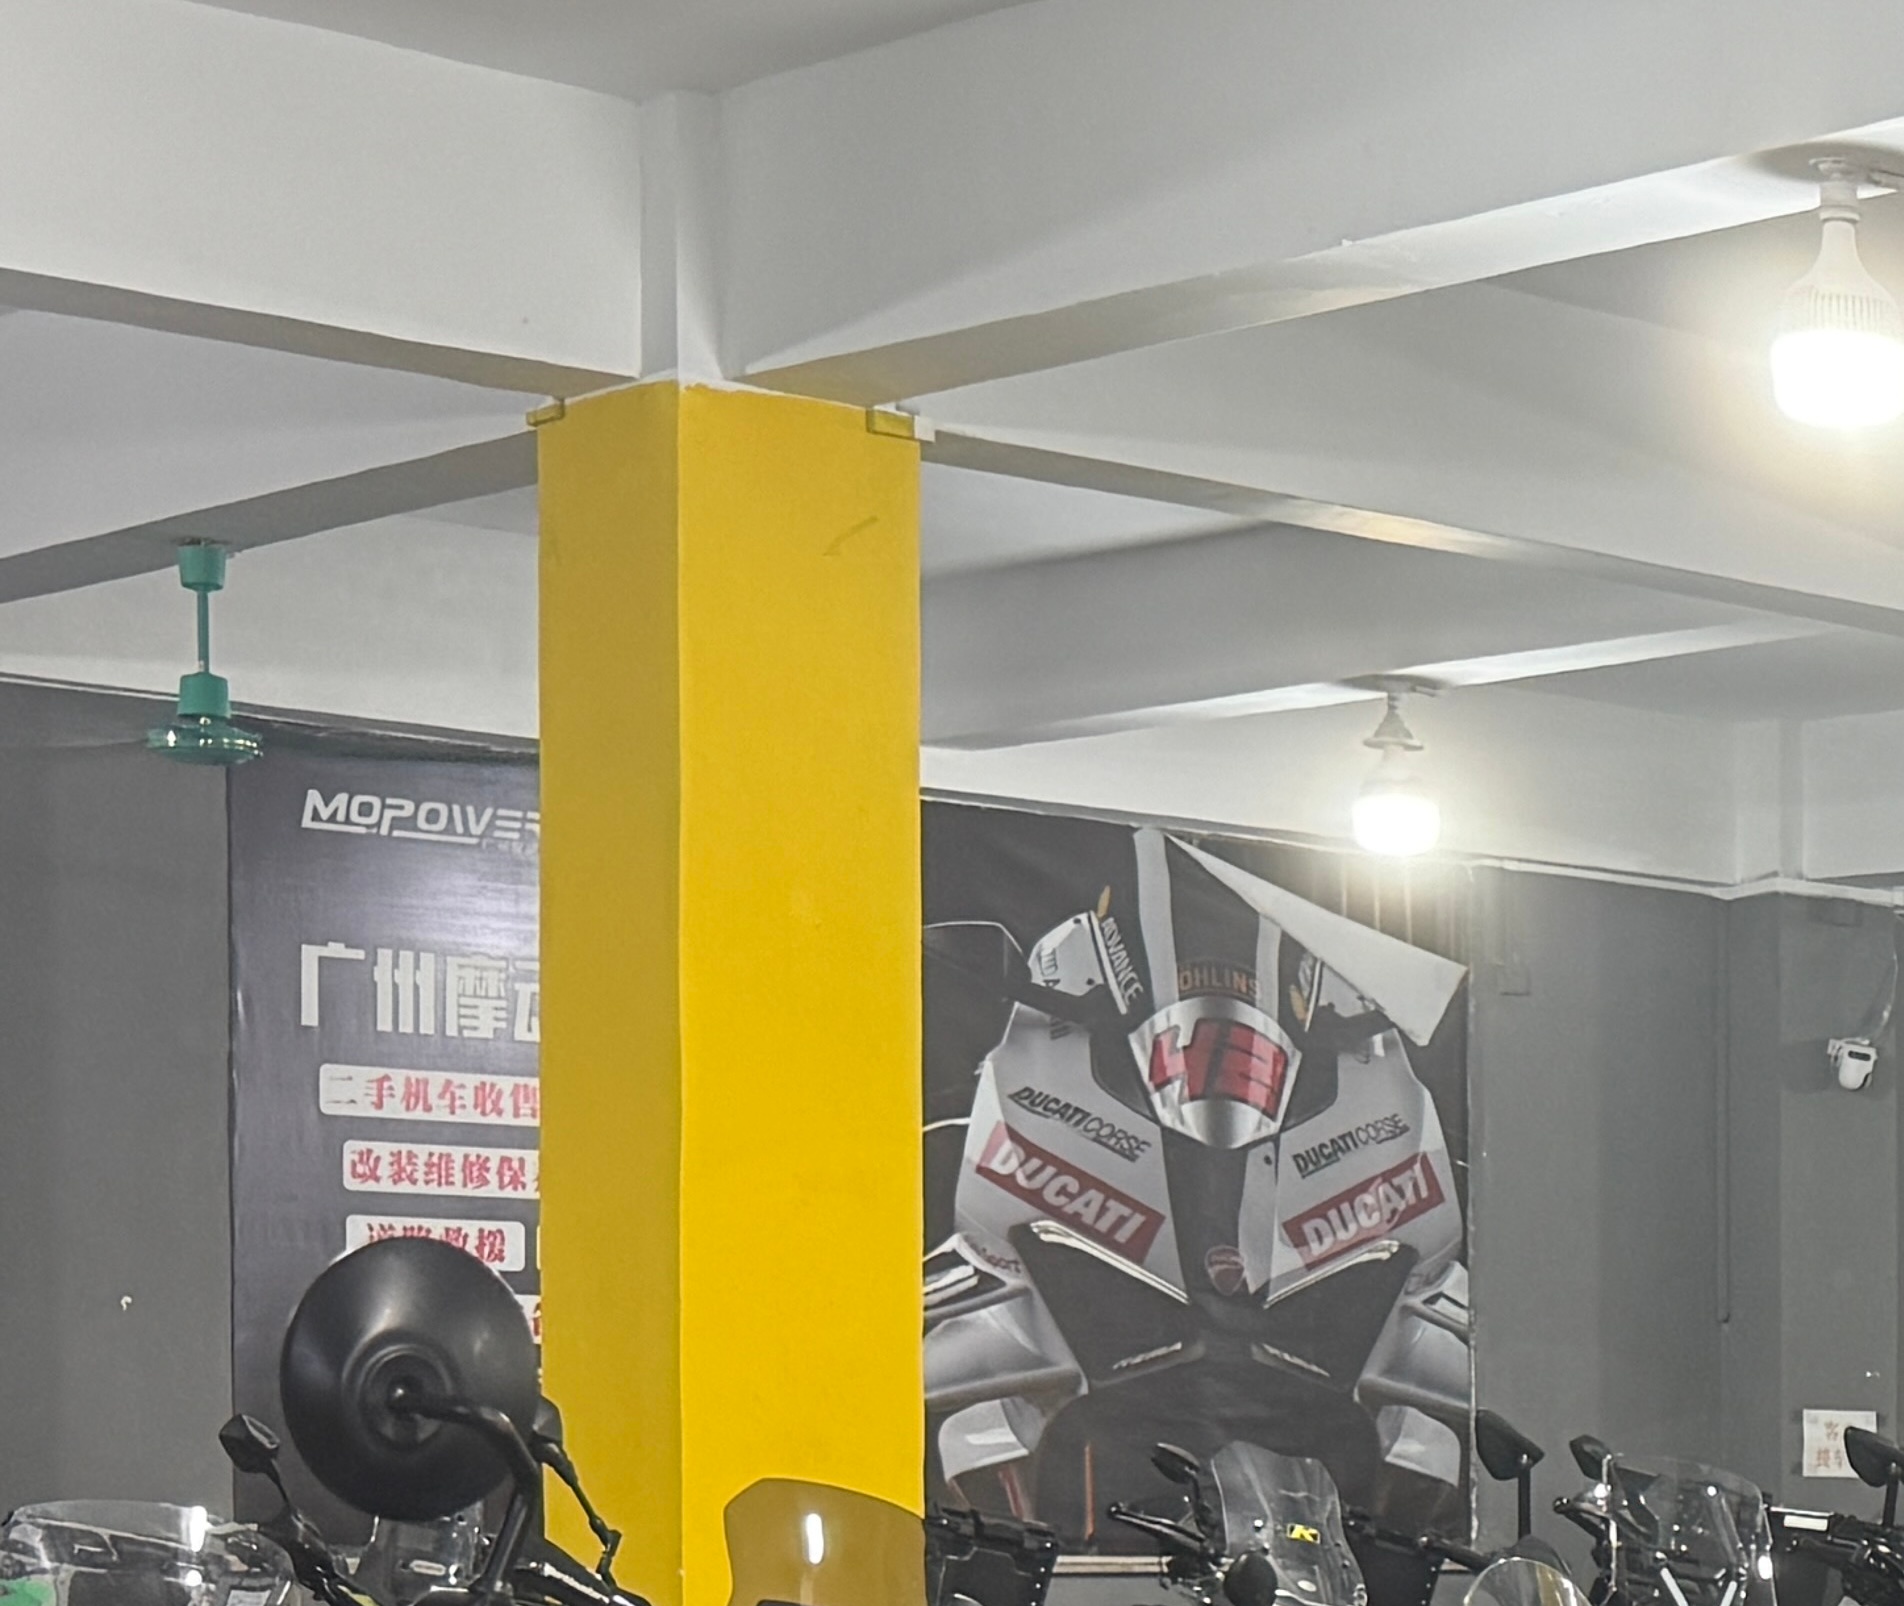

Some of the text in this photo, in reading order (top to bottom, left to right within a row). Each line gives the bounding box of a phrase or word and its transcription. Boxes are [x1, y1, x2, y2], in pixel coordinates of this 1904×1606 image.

[350, 1148, 540, 1192] 改装维修保
[990, 1138, 1147, 1244] DUCATI
[1302, 1160, 1430, 1257] DUCATI
